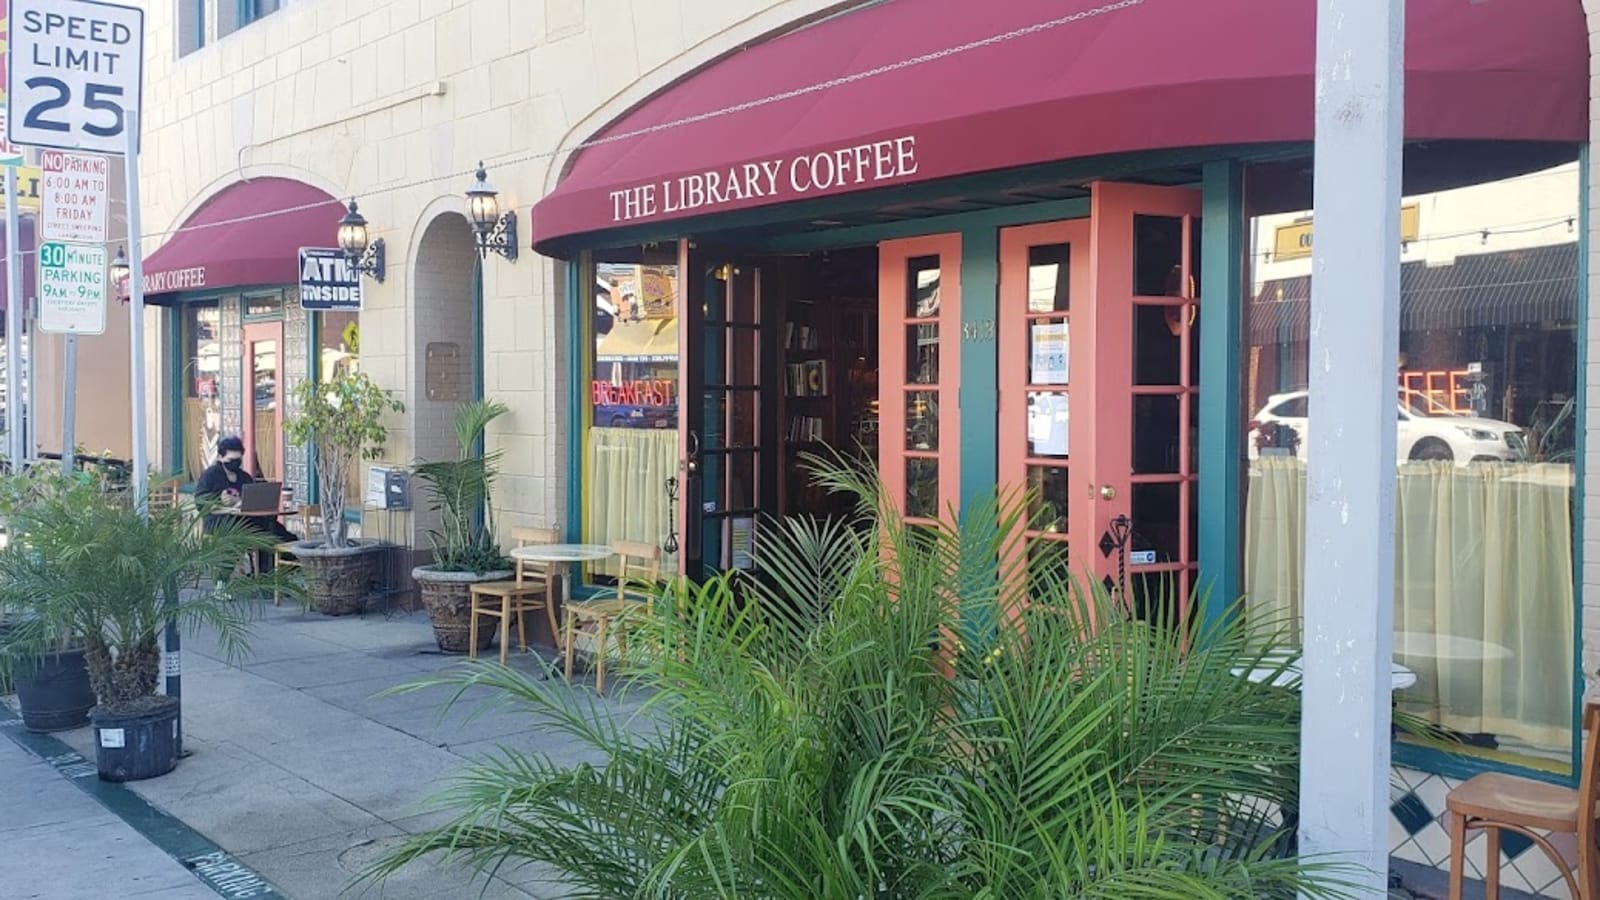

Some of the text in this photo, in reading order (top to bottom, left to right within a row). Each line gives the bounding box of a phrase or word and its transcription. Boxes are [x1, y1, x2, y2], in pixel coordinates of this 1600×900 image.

[23, 10, 131, 45] SPEED
[33, 43, 120, 75] LIMIT
[23, 76, 124, 137] 25
[44, 153, 106, 175] NO PARKING
[46, 176, 104, 191] 6:00 AM TO
[610, 136, 918, 222] THE LIBRARY COFFEE
[81, 194, 96, 206] AM
[57, 208, 93, 220] FRIDAY
[42, 245, 103, 266] 30 MINUTE
[45, 269, 101, 284] PARKING
[167, 266, 205, 289] COFFEE
[302, 257, 359, 282] ATM
[302, 285, 360, 302] INSIDE
[592, 379, 672, 407] BREAKFAST
[1397, 370, 1472, 414] FEE
[186, 851, 273, 898] PARKING
